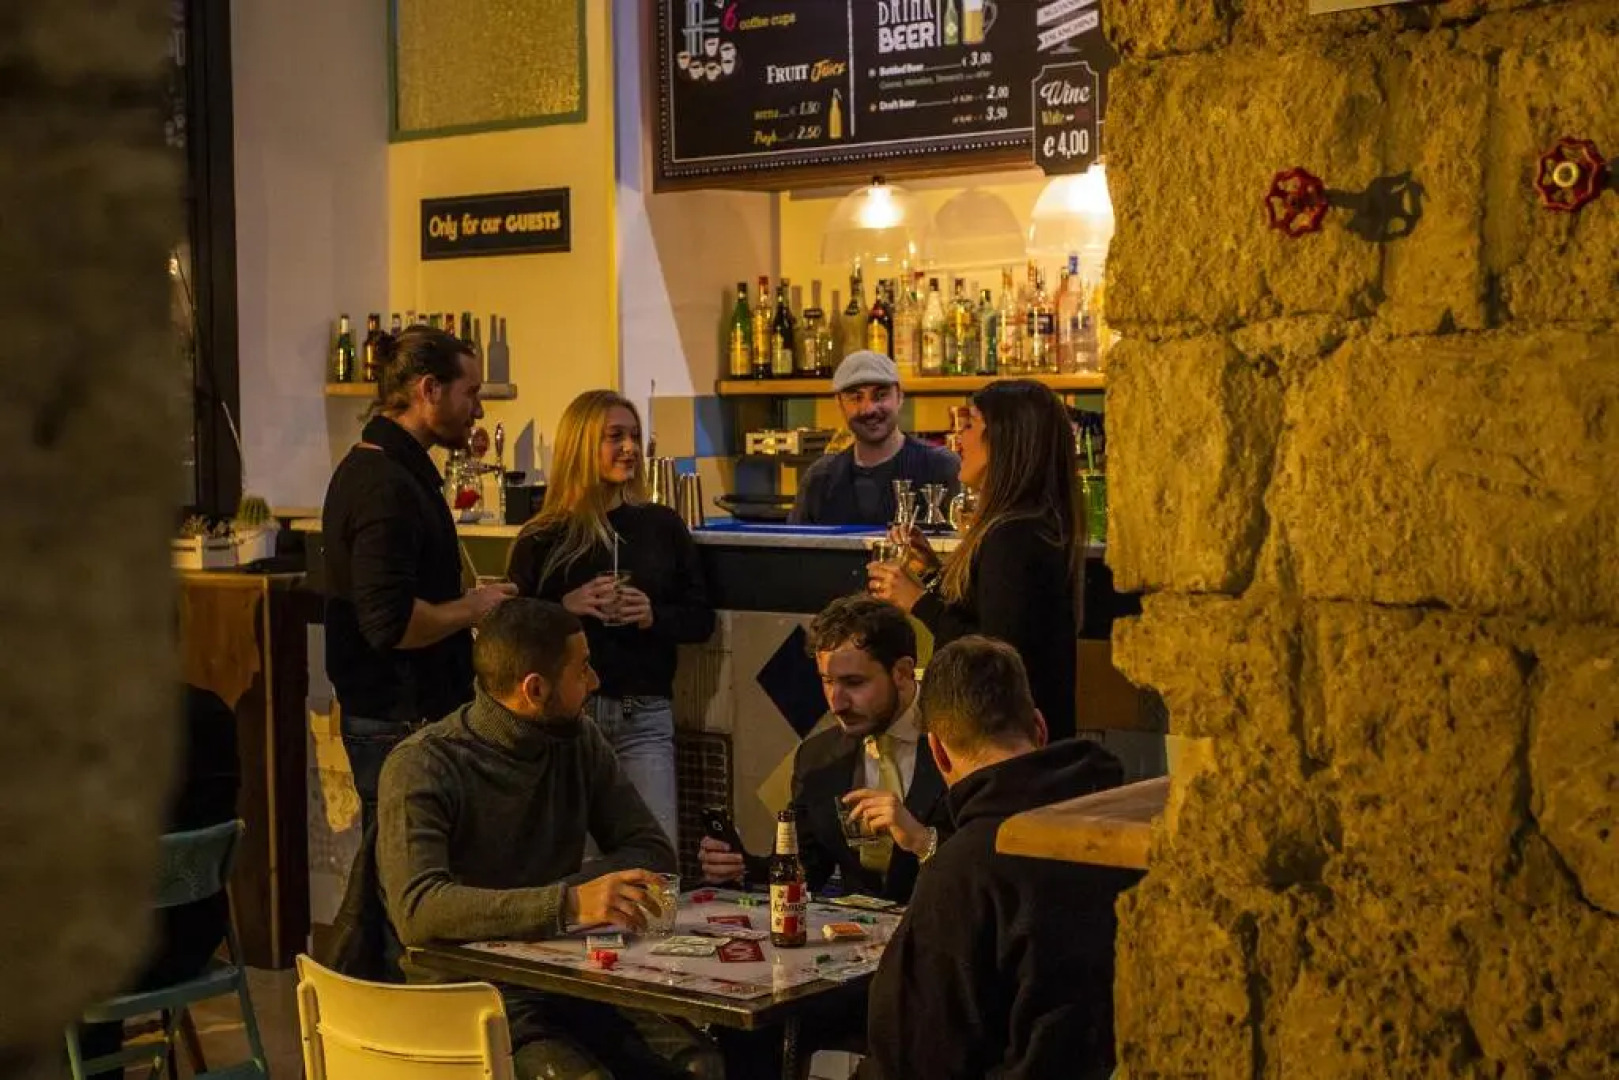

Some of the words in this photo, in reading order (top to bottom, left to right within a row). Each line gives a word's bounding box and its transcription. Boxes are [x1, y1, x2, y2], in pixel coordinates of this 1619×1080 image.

[878, 21, 935, 54] BEER
[766, 63, 810, 84] FRUIT
[1040, 80, 1090, 106] Wine
[1057, 128, 1089, 159] 4,00
[429, 213, 458, 241] Only
[462, 212, 479, 235] for
[480, 216, 501, 235] our
[505, 210, 561, 233] GUESTS
